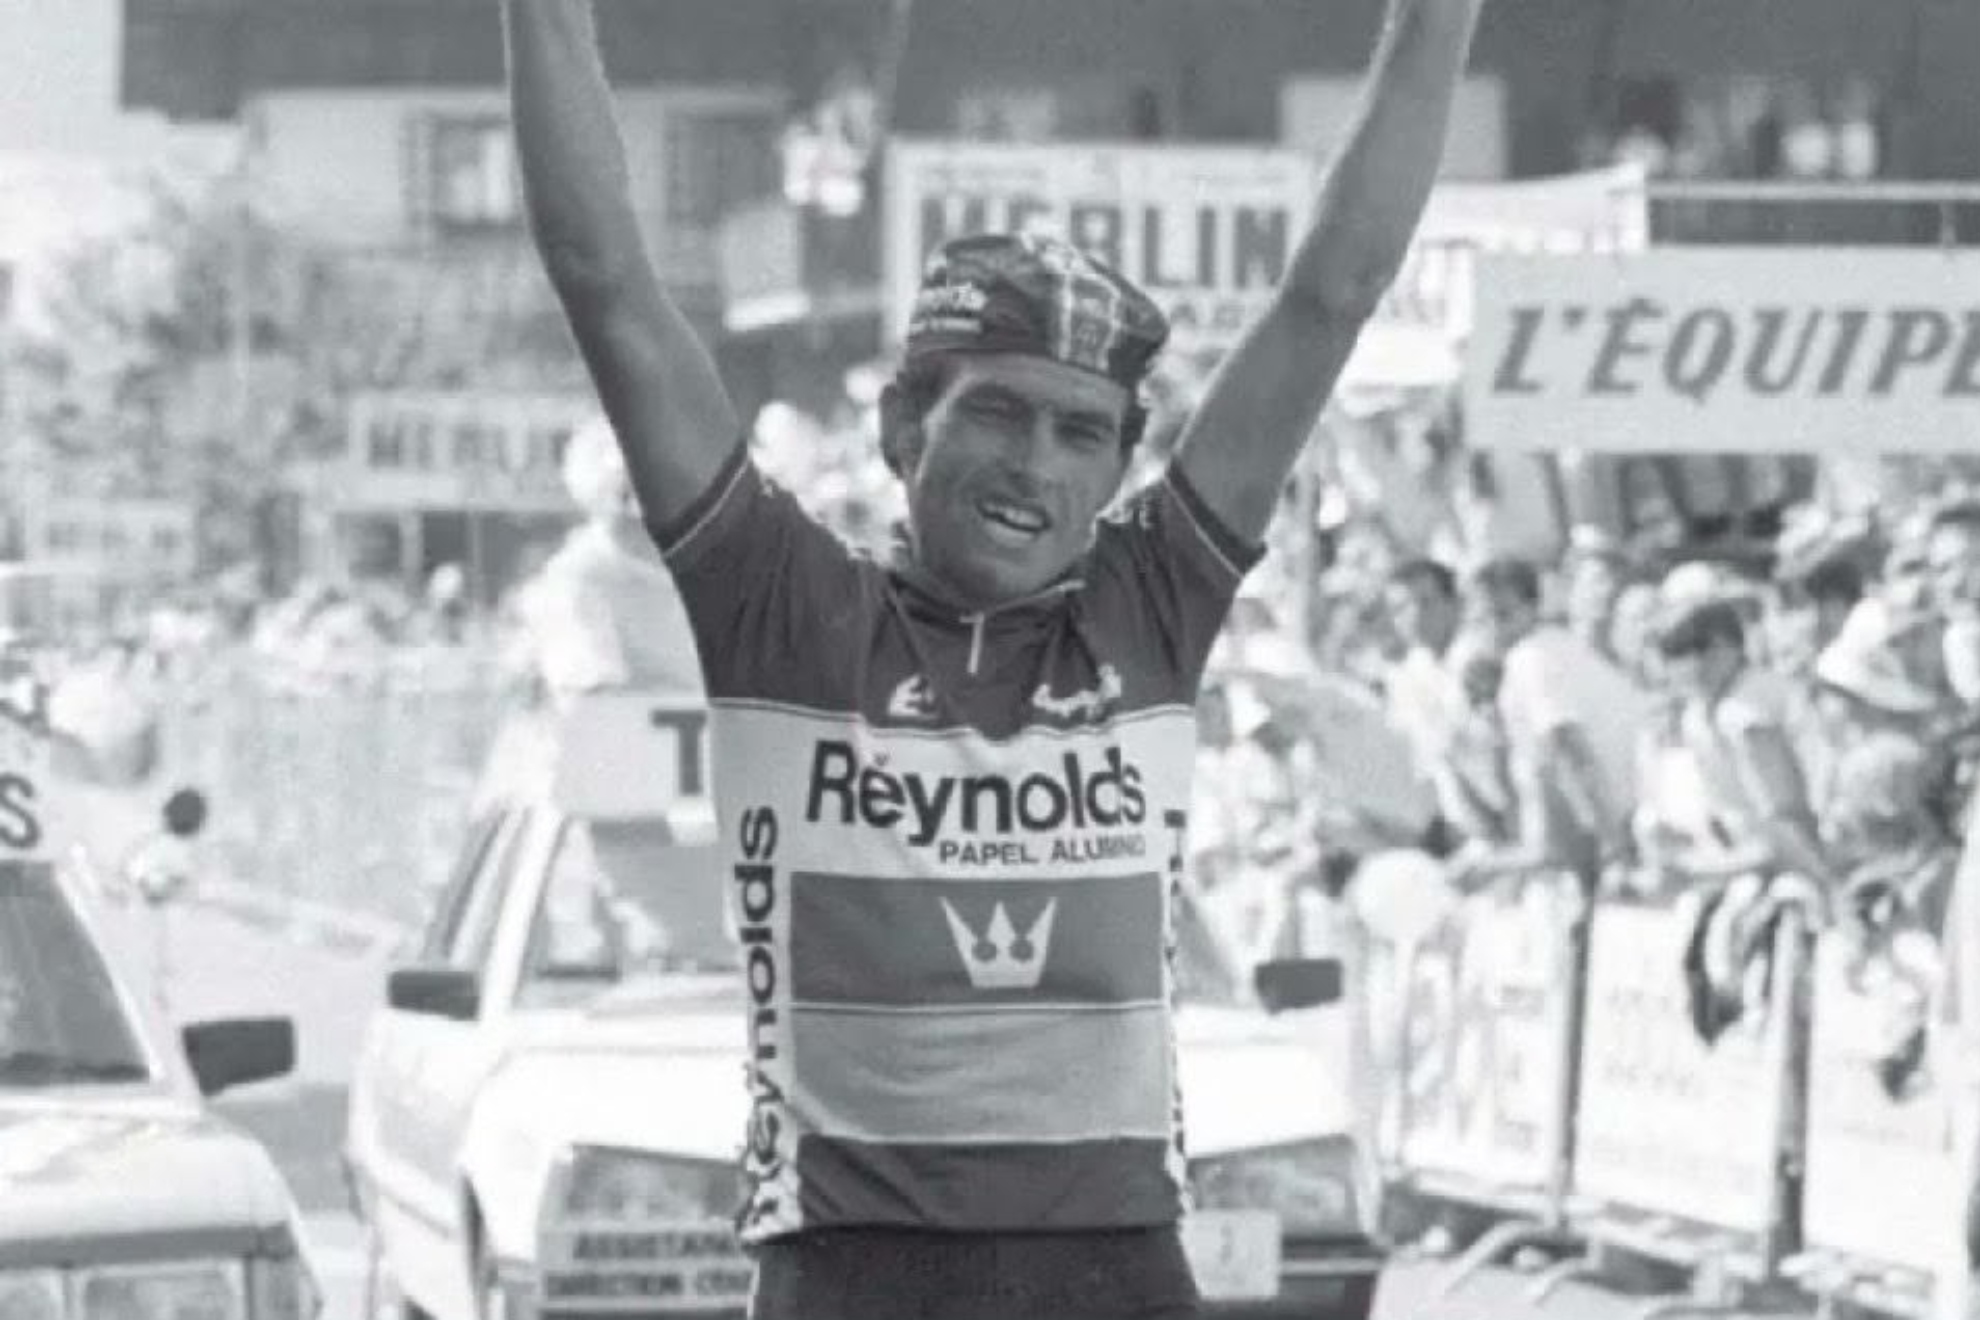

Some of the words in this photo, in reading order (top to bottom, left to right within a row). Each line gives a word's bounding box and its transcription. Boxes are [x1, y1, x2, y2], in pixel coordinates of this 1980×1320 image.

[652, 709, 706, 797] T
[806, 739, 1147, 848] Reynolds
[939, 839, 1039, 865] PAPEL
